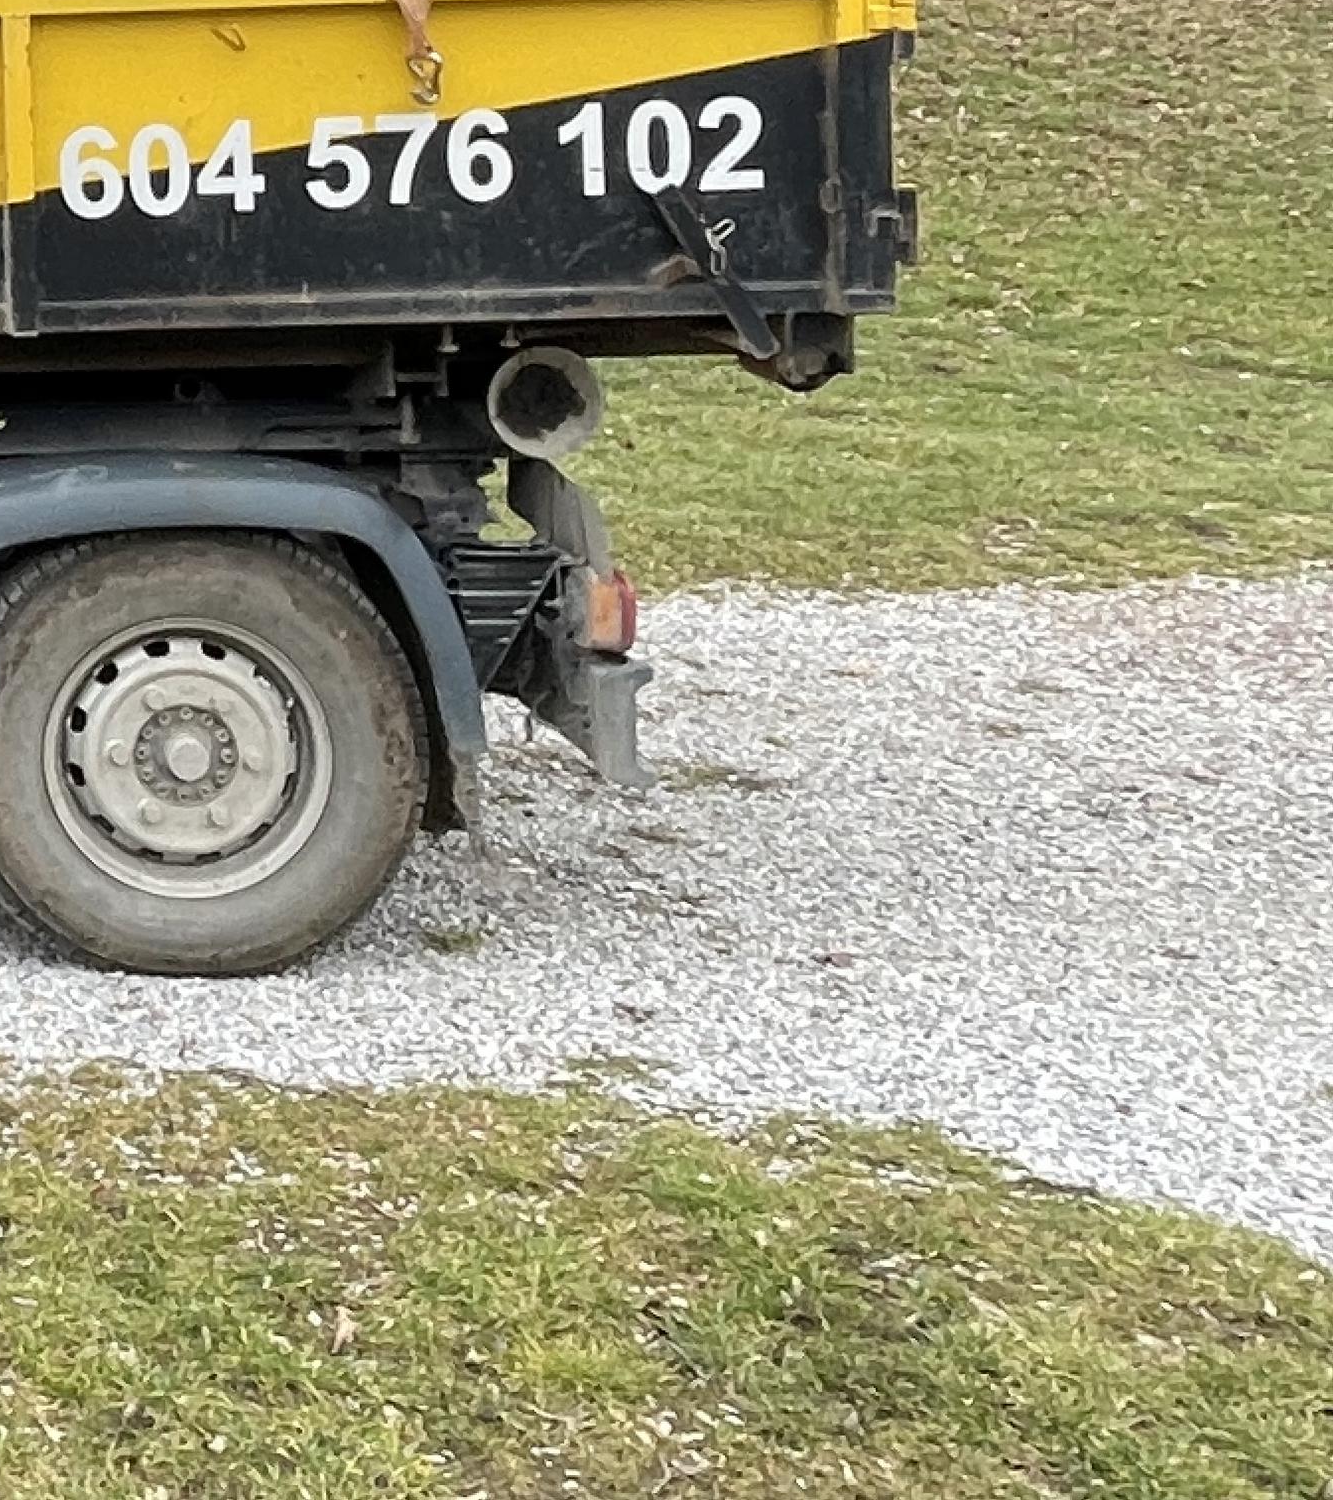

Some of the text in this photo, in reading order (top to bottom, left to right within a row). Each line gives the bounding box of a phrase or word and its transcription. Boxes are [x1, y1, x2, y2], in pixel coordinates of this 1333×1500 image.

[59, 95, 766, 220] 604 576 102
